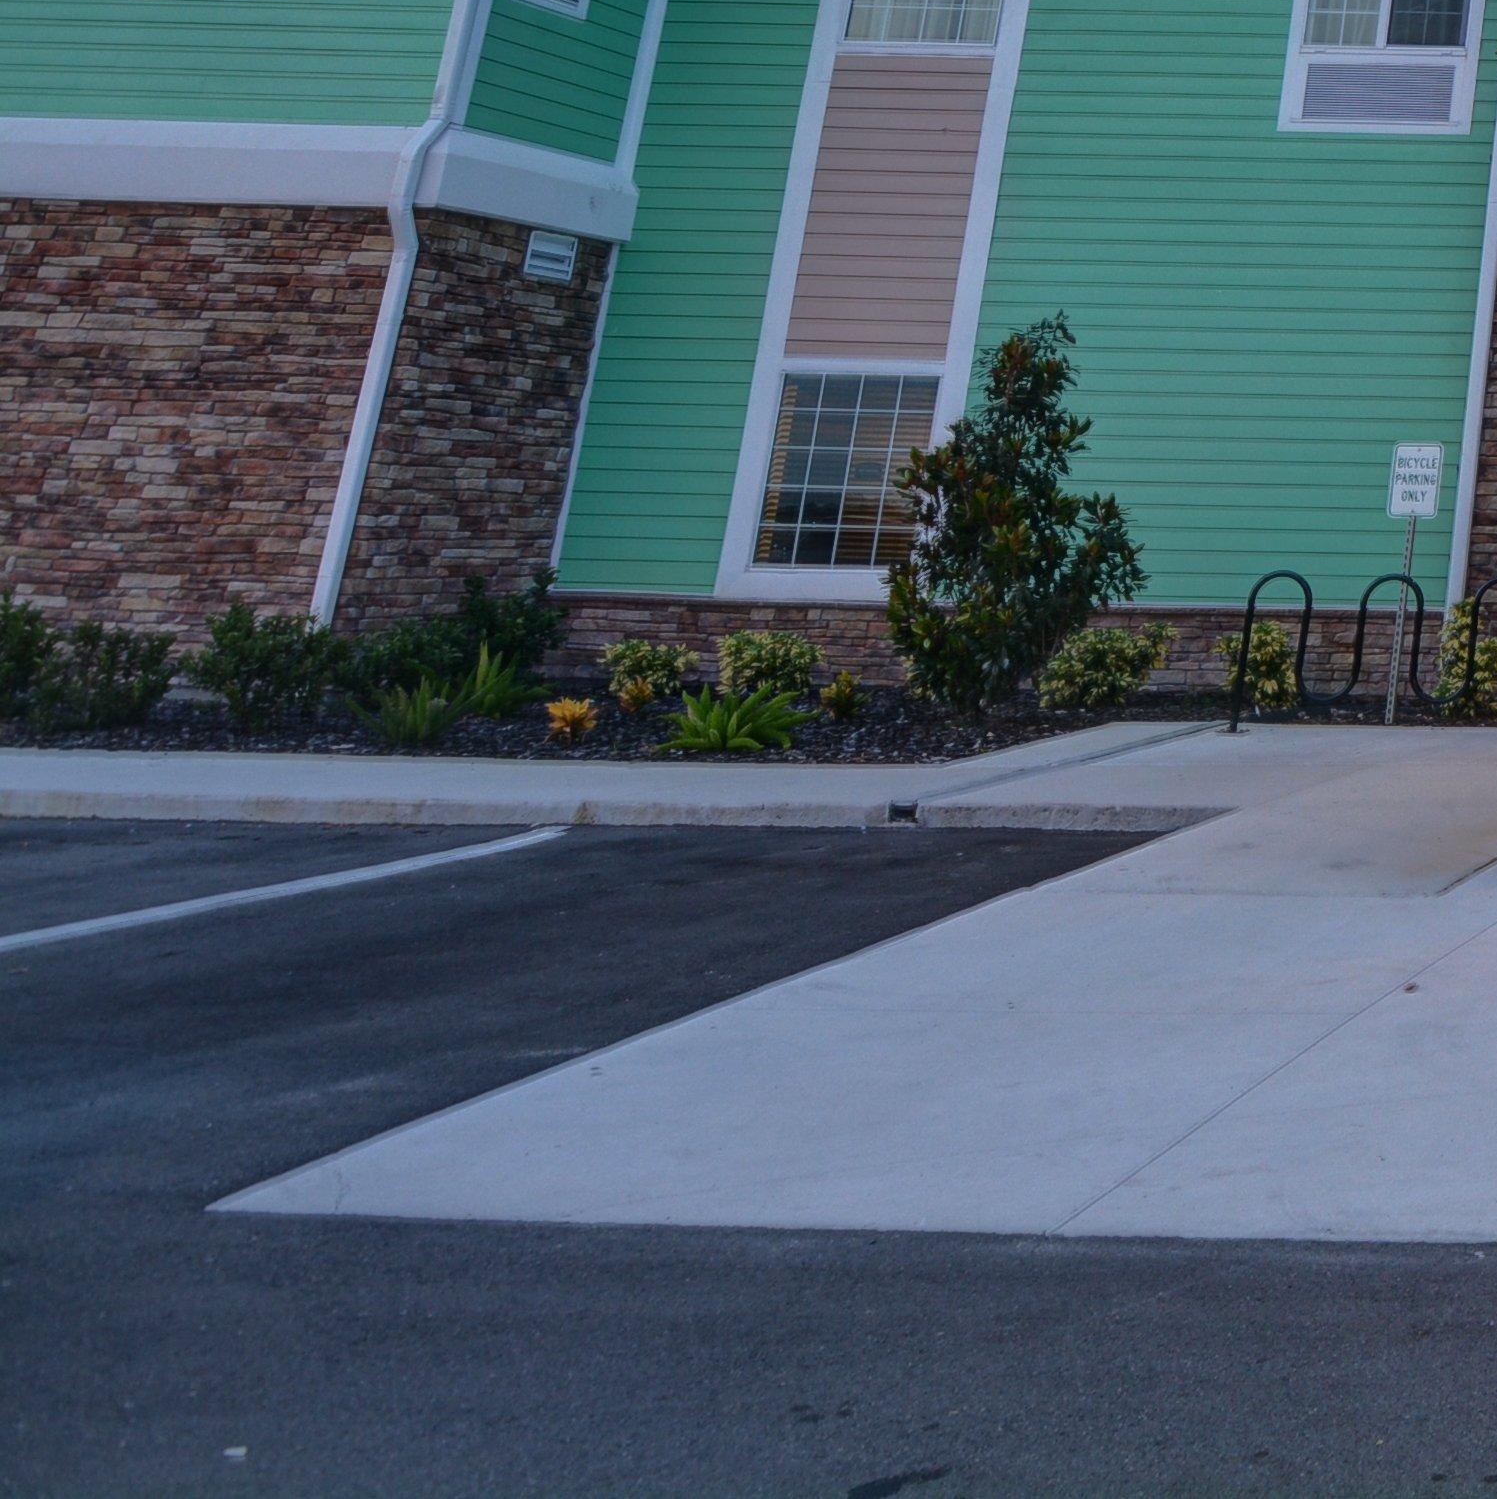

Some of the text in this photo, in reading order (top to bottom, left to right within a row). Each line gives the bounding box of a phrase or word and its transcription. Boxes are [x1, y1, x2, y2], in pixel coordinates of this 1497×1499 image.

[1397, 457, 1438, 470] BICYCLE
[1395, 474, 1437, 486] PARKING
[1401, 490, 1427, 502] ONLY
